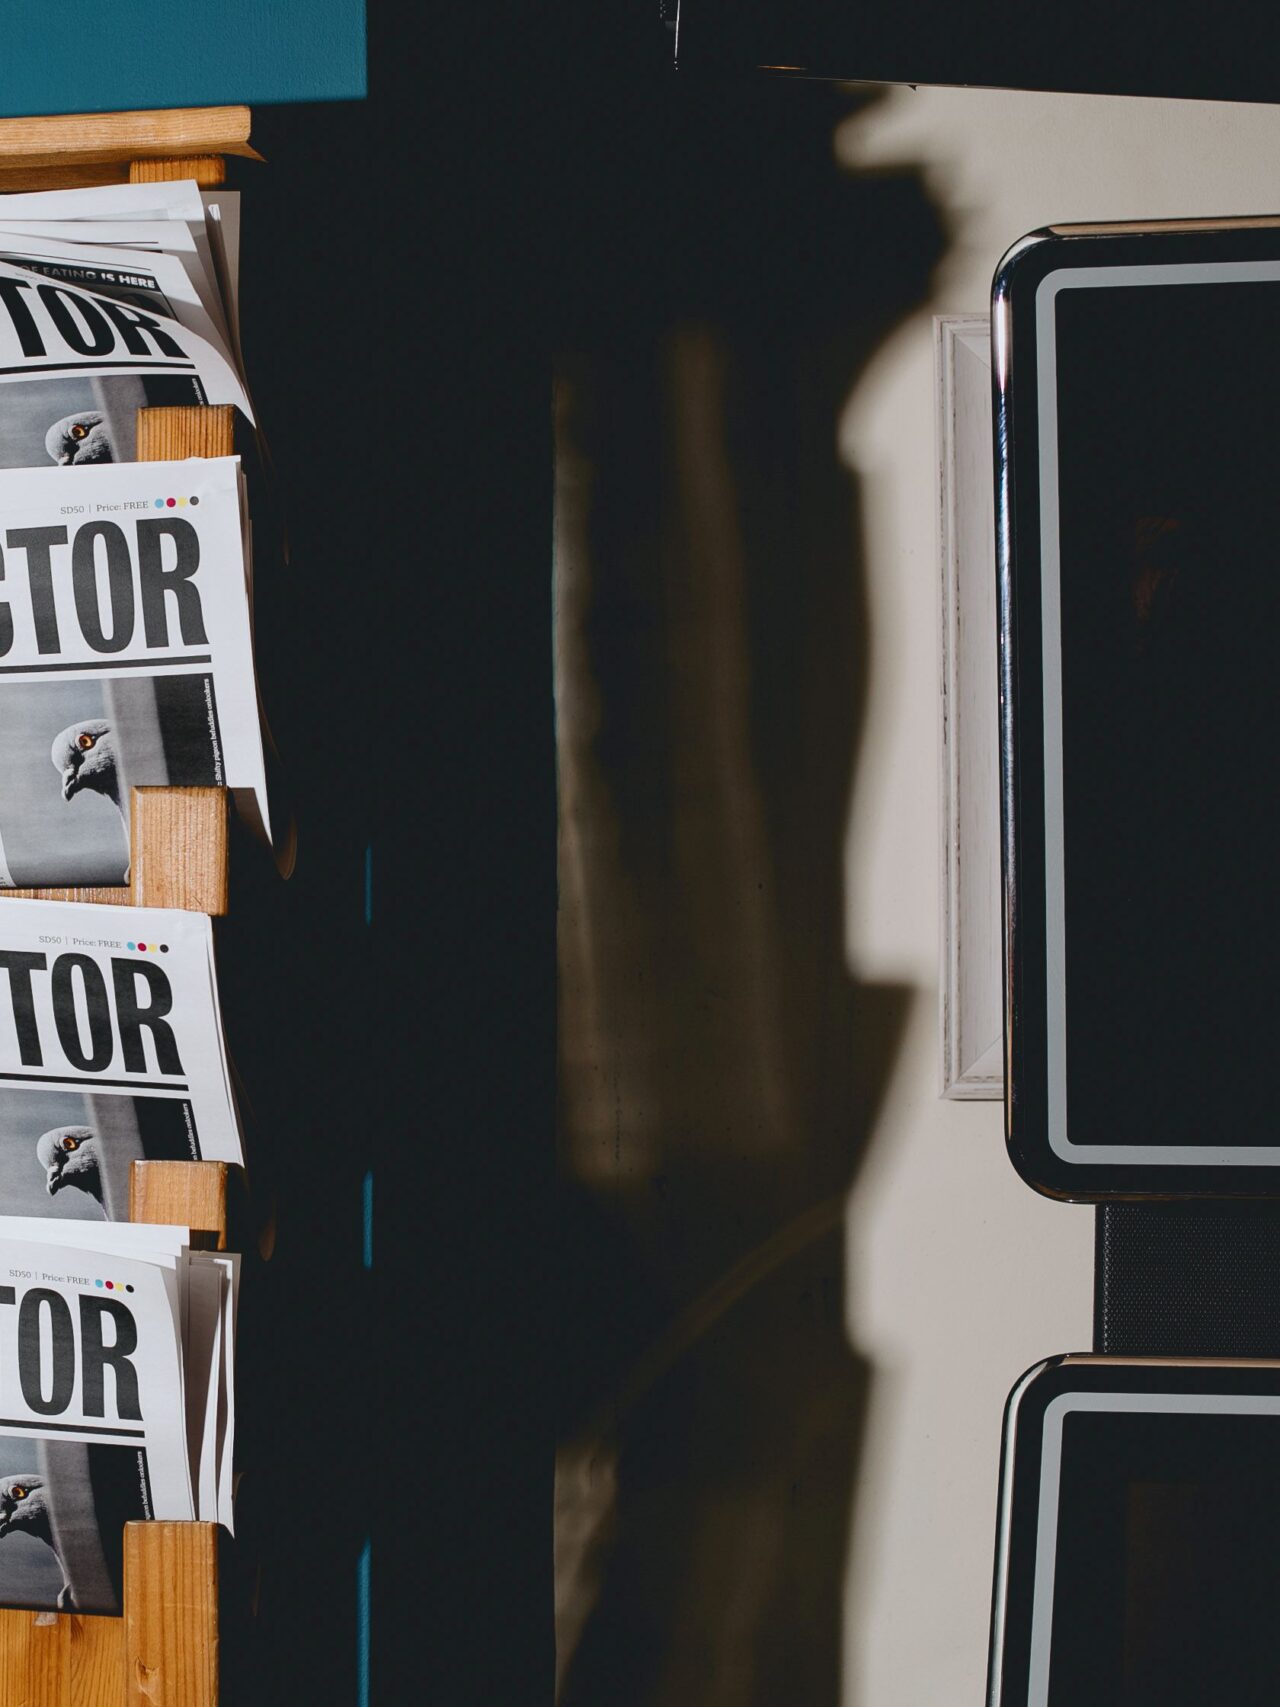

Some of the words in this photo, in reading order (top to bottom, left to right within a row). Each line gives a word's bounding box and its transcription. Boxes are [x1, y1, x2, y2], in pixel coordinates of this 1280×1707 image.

[42, 266, 97, 280] EATING
[101, 273, 115, 282] IS
[119, 275, 156, 289] HERE
[60, 505, 85, 514] SD50
[96, 504, 121, 512] Price:
[123, 501, 149, 511] FREE
[39, 935, 61, 944] SD50
[99, 939, 122, 949] FREE
[9, 1269, 31, 1279] SD50
[66, 1275, 90, 1286] FREE
